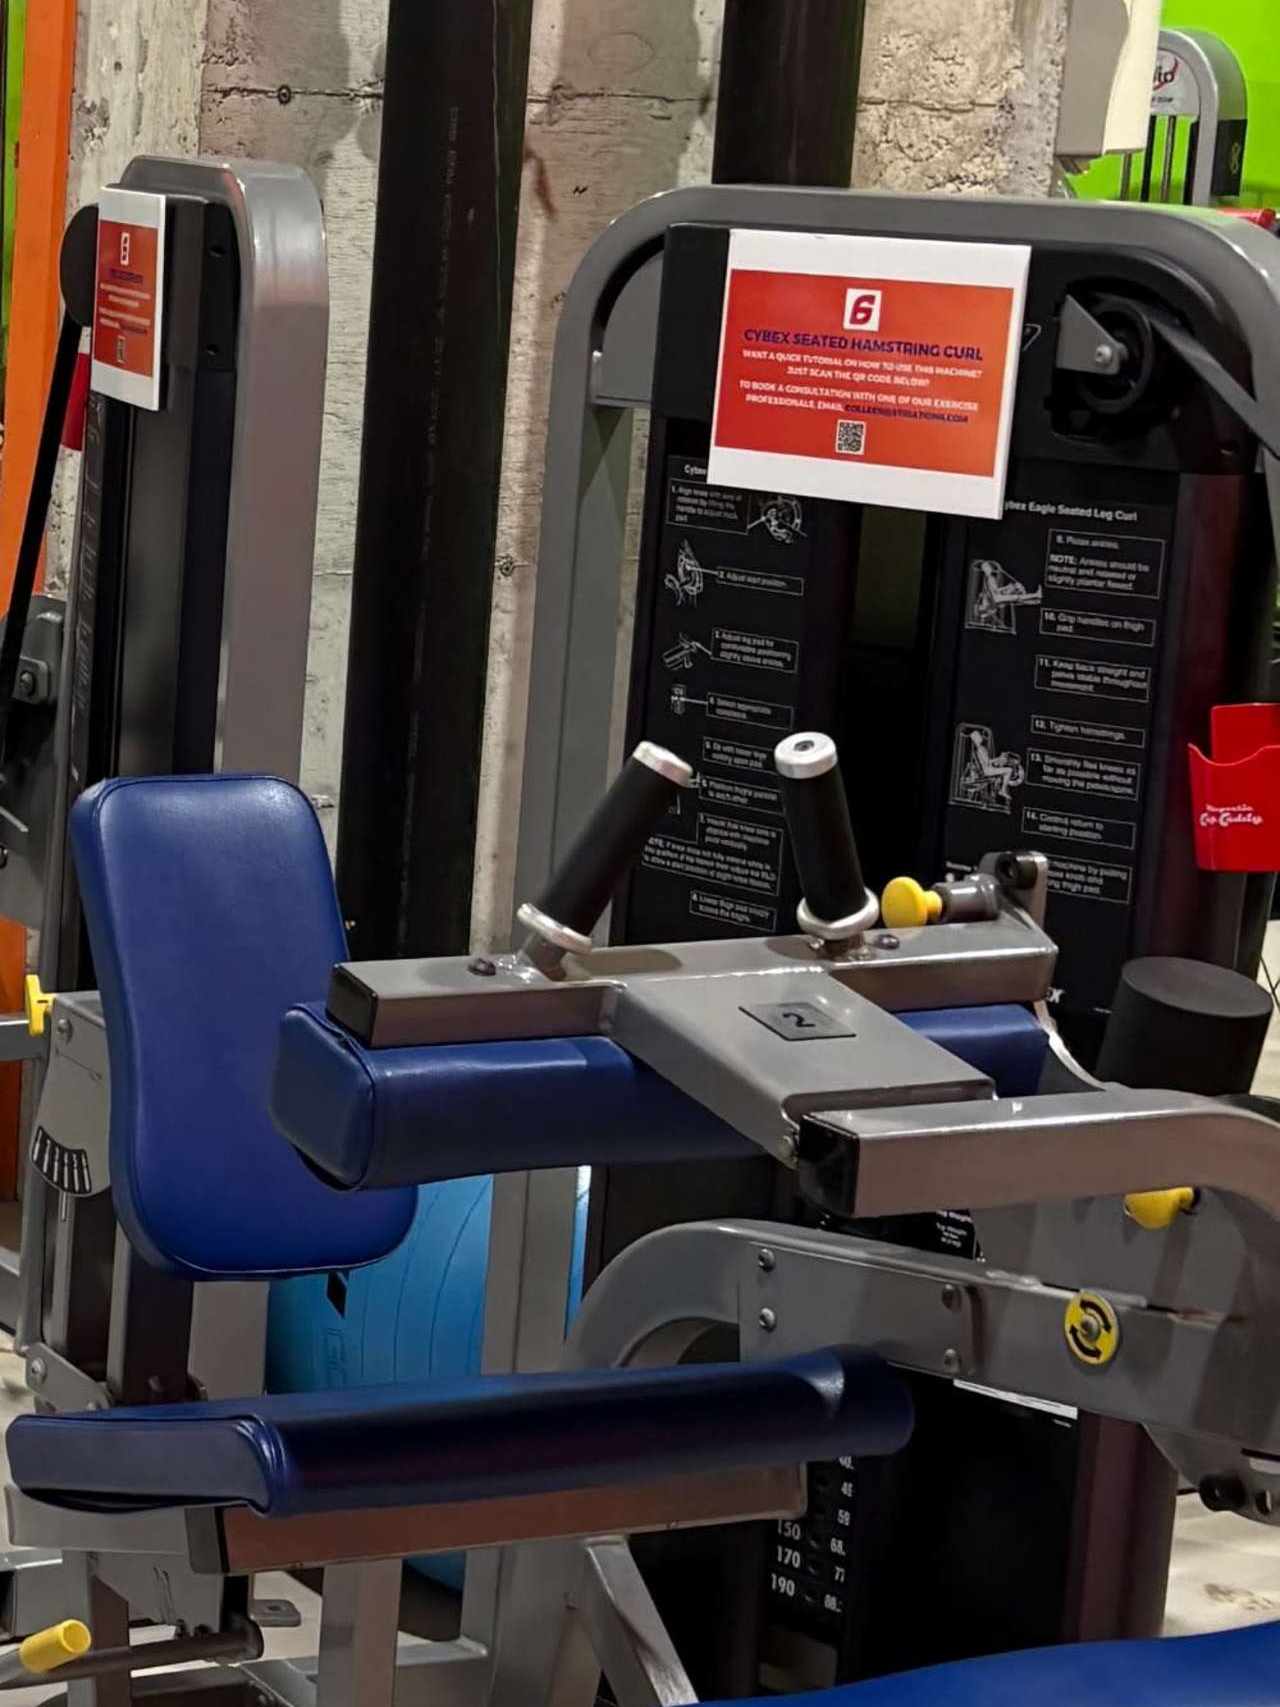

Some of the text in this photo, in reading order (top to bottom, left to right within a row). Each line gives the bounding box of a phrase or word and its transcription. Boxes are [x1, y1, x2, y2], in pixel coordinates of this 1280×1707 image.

[743, 329, 983, 359] CYBEX SEATED HAMSTRING CURL
[741, 349, 768, 360] WANT
[767, 351, 774, 361] A
[775, 352, 801, 363] QUICK
[802, 354, 842, 366] TUTORIAL
[843, 358, 856, 367] ON
[858, 359, 880, 369] HOW
[881, 361, 894, 371] TO
[895, 362, 913, 372] USE
[914, 363, 933, 374] THIS
[786, 366, 808, 376] JUST
[808, 367, 833, 378] SCAN
[834, 370, 851, 379] THE
[851, 371, 866, 382] QR
[867, 372, 892, 383] CODE
[739, 379, 978, 410] TO BOOK A CONSULTATION WITH ONE OF OUR EXERCISE
[1028, 501, 1056, 515] Eagle
[1057, 503, 1093, 517] Seated
[1094, 506, 1114, 521] Leg
[1115, 507, 1138, 521] Curl
[777, 1519, 801, 1541] 150
[776, 1545, 801, 1569] 170
[770, 1573, 795, 1597] 190
